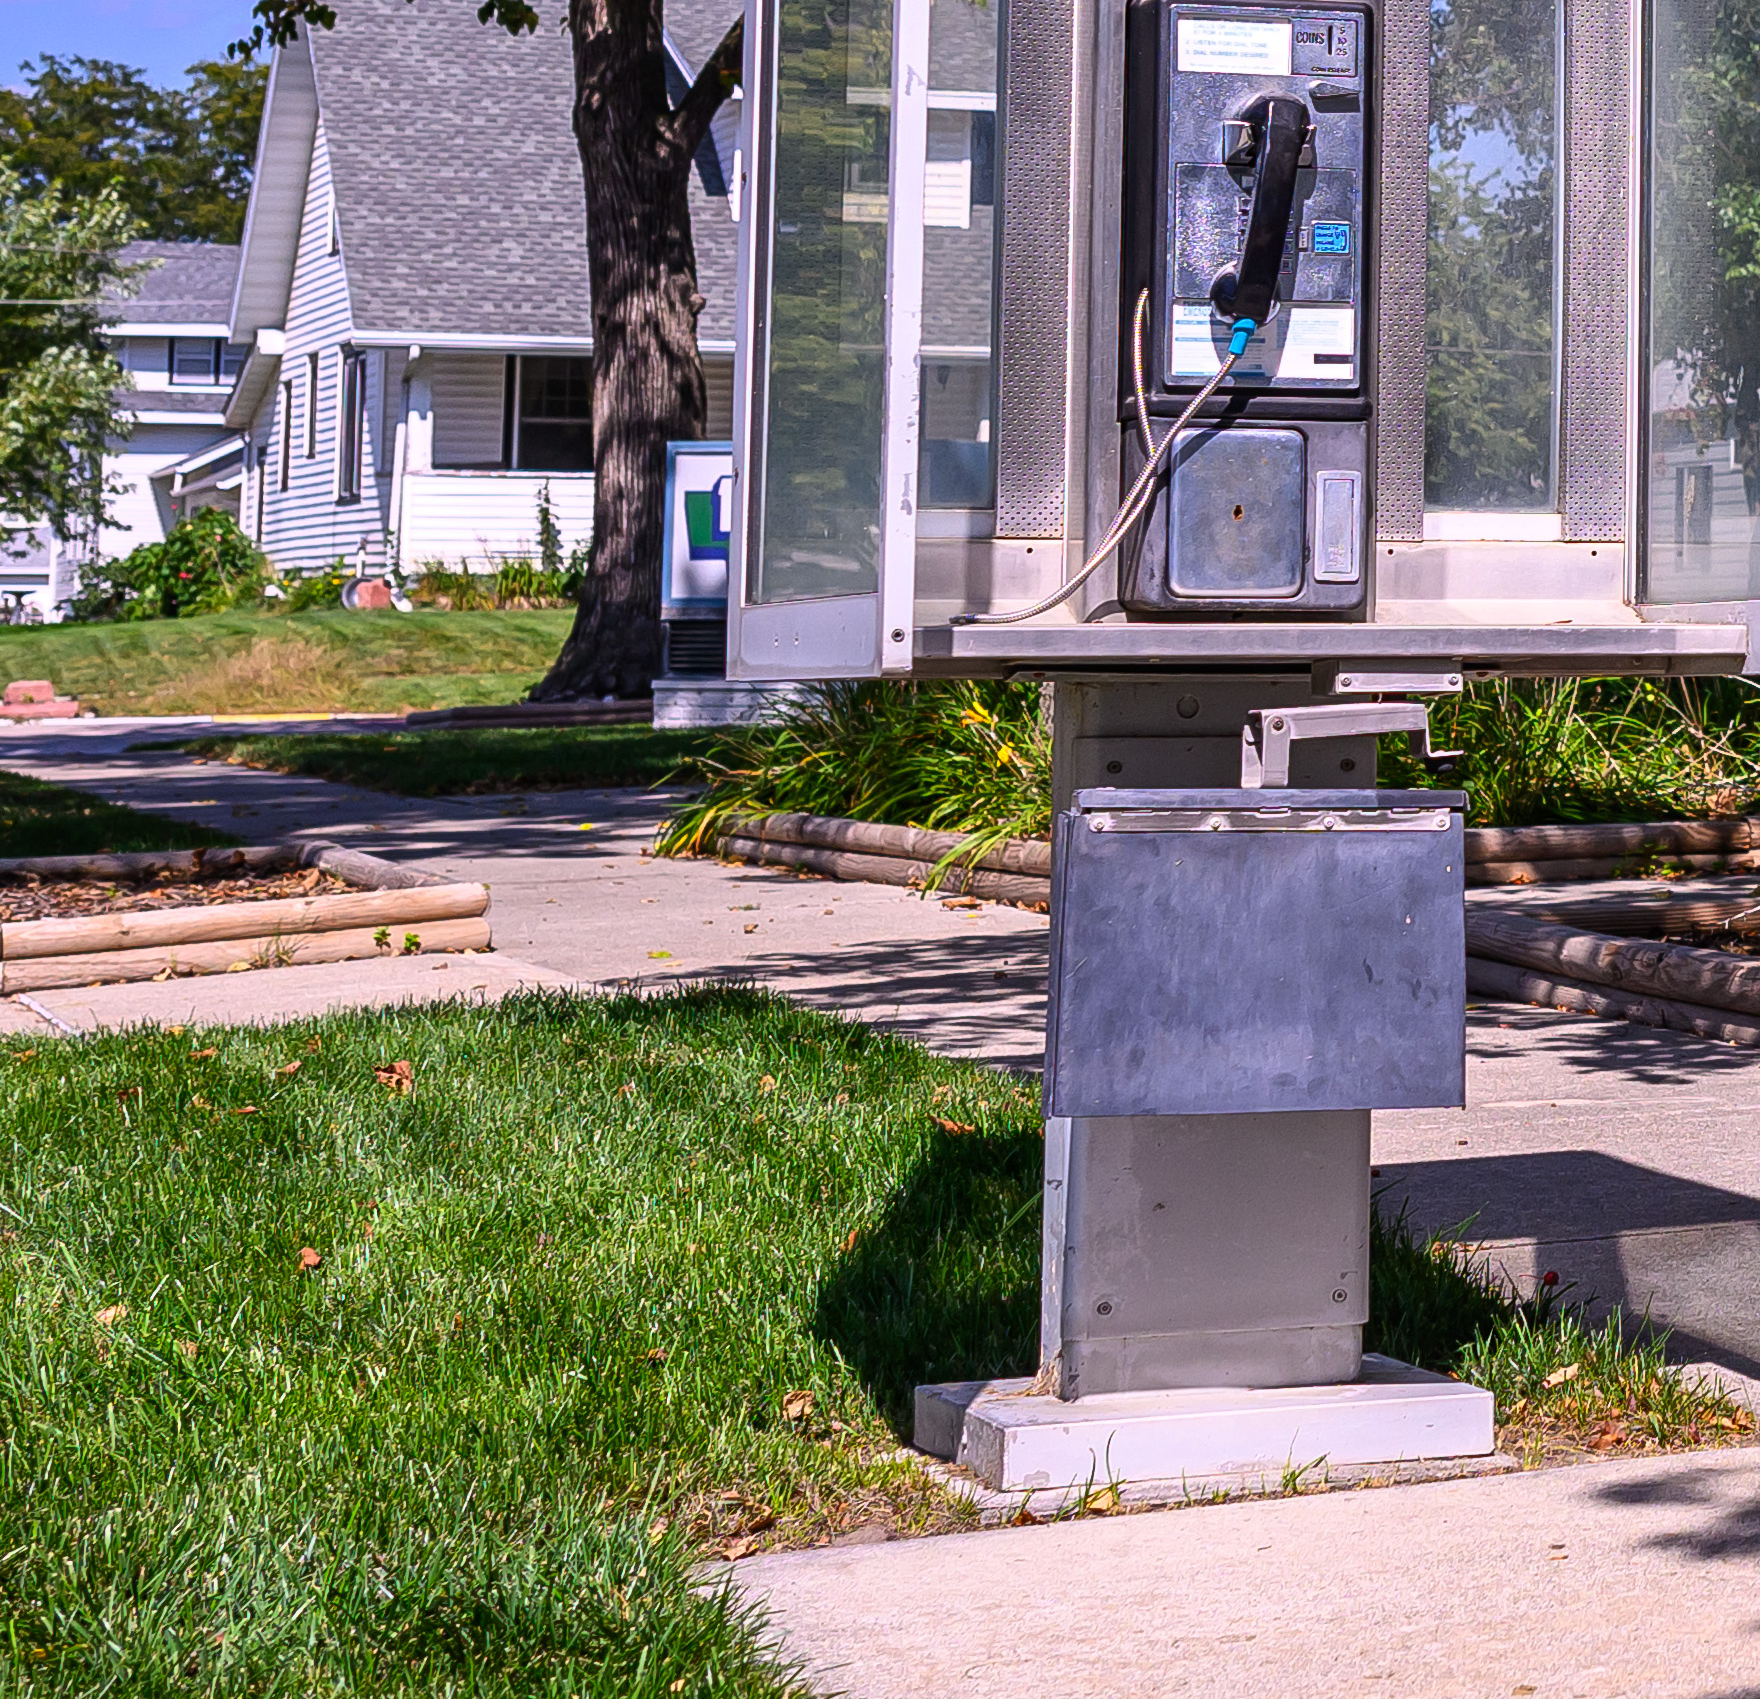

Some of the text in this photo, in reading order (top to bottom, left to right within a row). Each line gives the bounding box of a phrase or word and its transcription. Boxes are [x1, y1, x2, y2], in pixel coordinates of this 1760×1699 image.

[1340, 26, 1346, 34] 5
[1296, 32, 1325, 44] COINS
[1337, 37, 1348, 45] 10
[1336, 48, 1348, 56] 25
